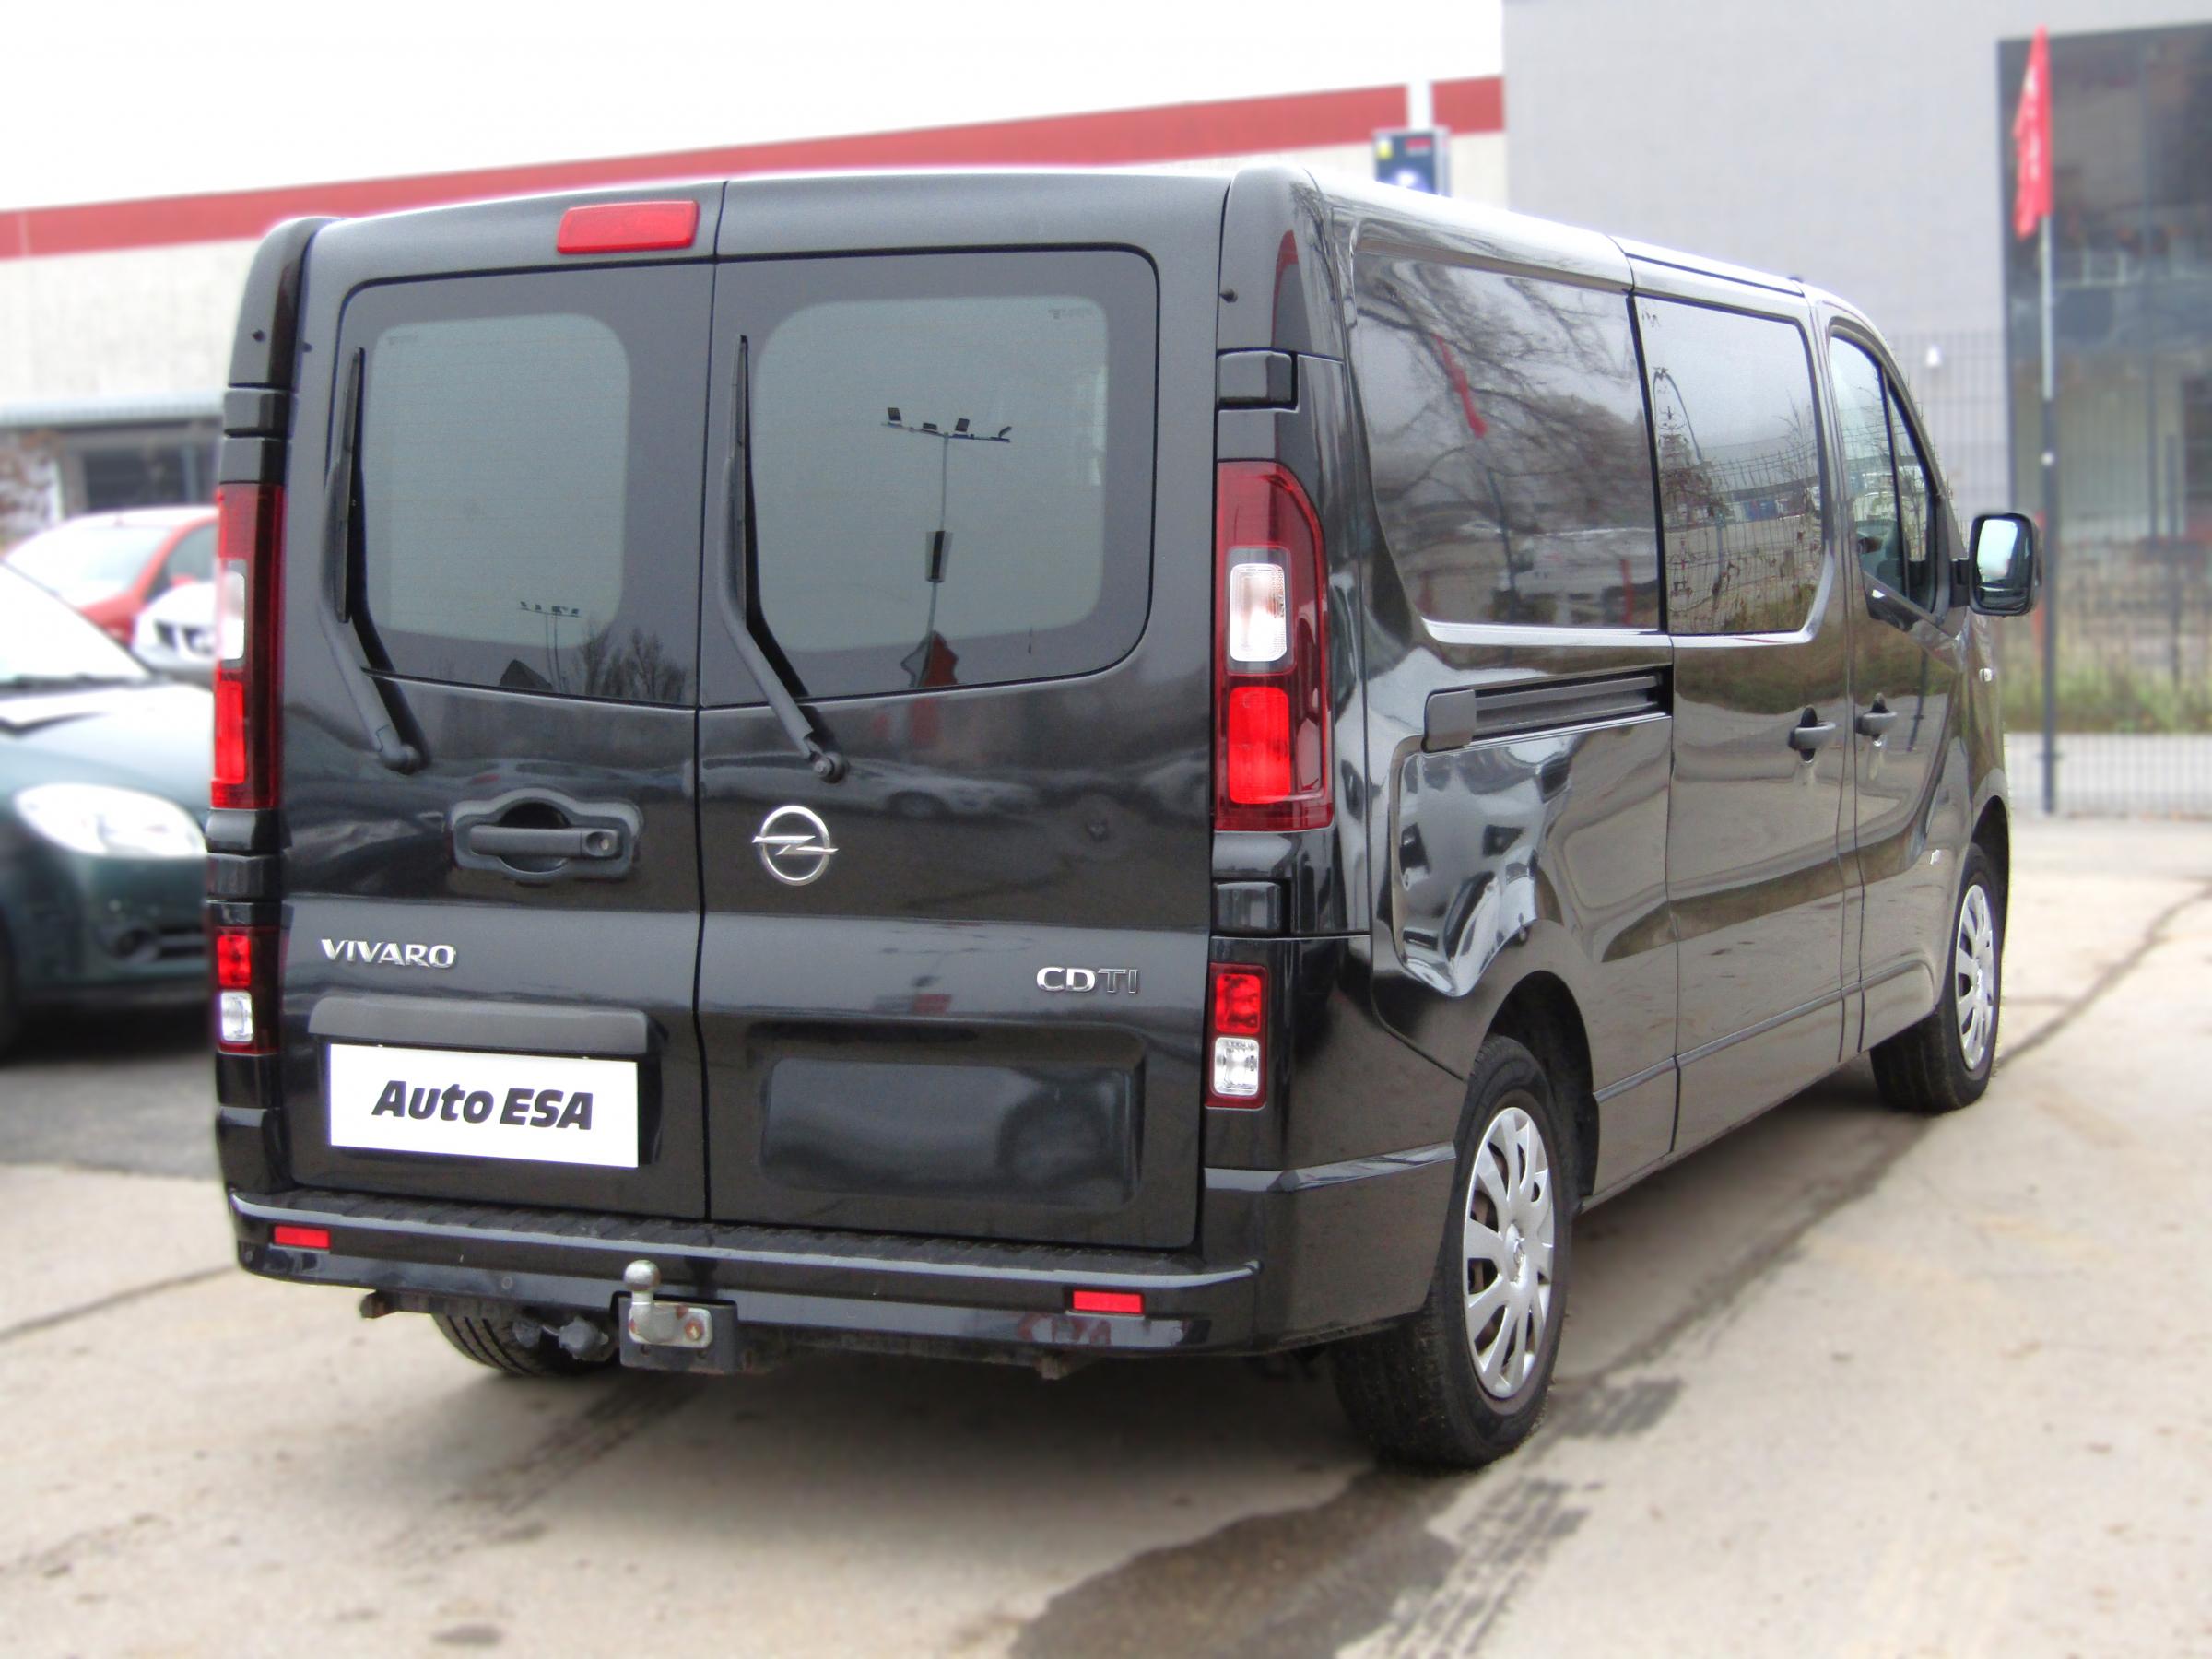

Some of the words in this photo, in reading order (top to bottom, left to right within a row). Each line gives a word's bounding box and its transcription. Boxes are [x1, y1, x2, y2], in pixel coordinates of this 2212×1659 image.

[321, 938, 456, 968] VIVARO
[1036, 966, 1138, 994] CDTI
[371, 1080, 494, 1124] Auto
[500, 1088, 594, 1130] ESA
